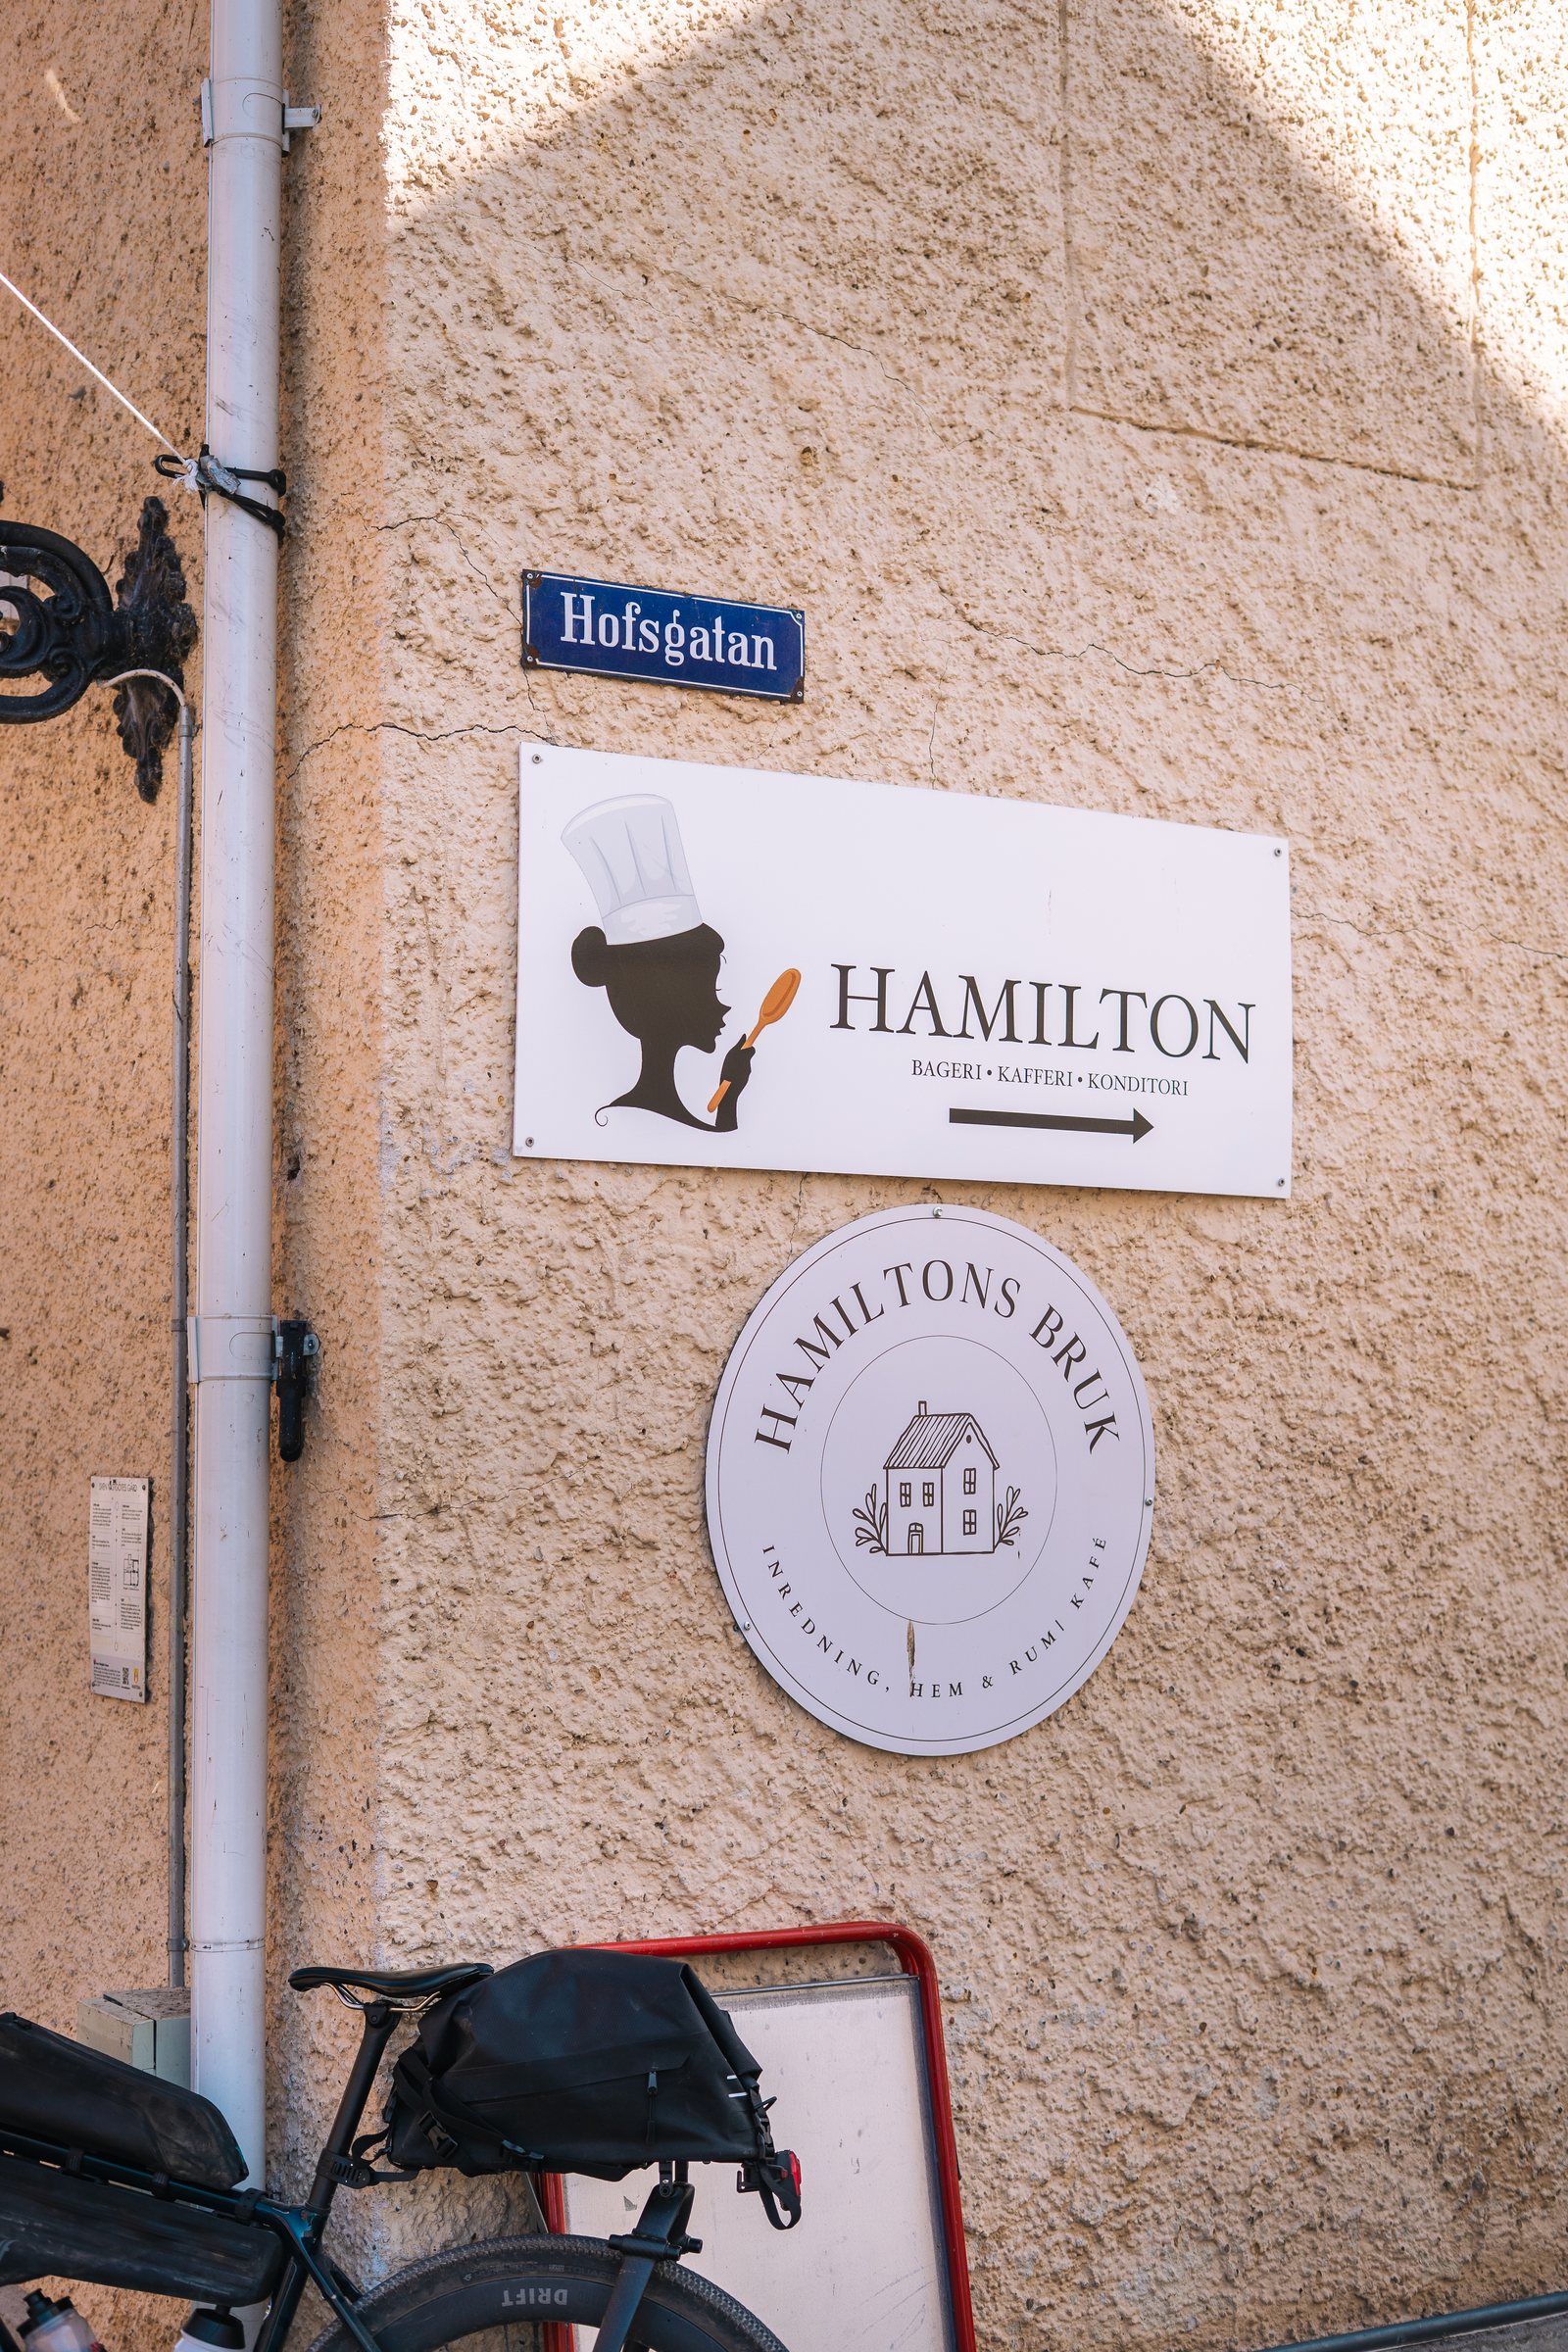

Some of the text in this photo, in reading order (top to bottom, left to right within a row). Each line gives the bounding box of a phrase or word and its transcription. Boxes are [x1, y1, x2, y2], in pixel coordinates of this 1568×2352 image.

[560, 591, 777, 670] Hofsgatan
[830, 963, 1256, 1064] HAMILTON
[911, 1058, 1189, 1097] BAGERI KAFFERI KONDITORI
[754, 1259, 1121, 1454] HAMILTONS BRUK
[762, 1544, 890, 1693] INREDNING,
[909, 1682, 962, 1697] HEM
[982, 1675, 993, 1689] &
[1069, 1538, 1106, 1609] KAFÉ
[502, 2287, 568, 2307] DRIFT
